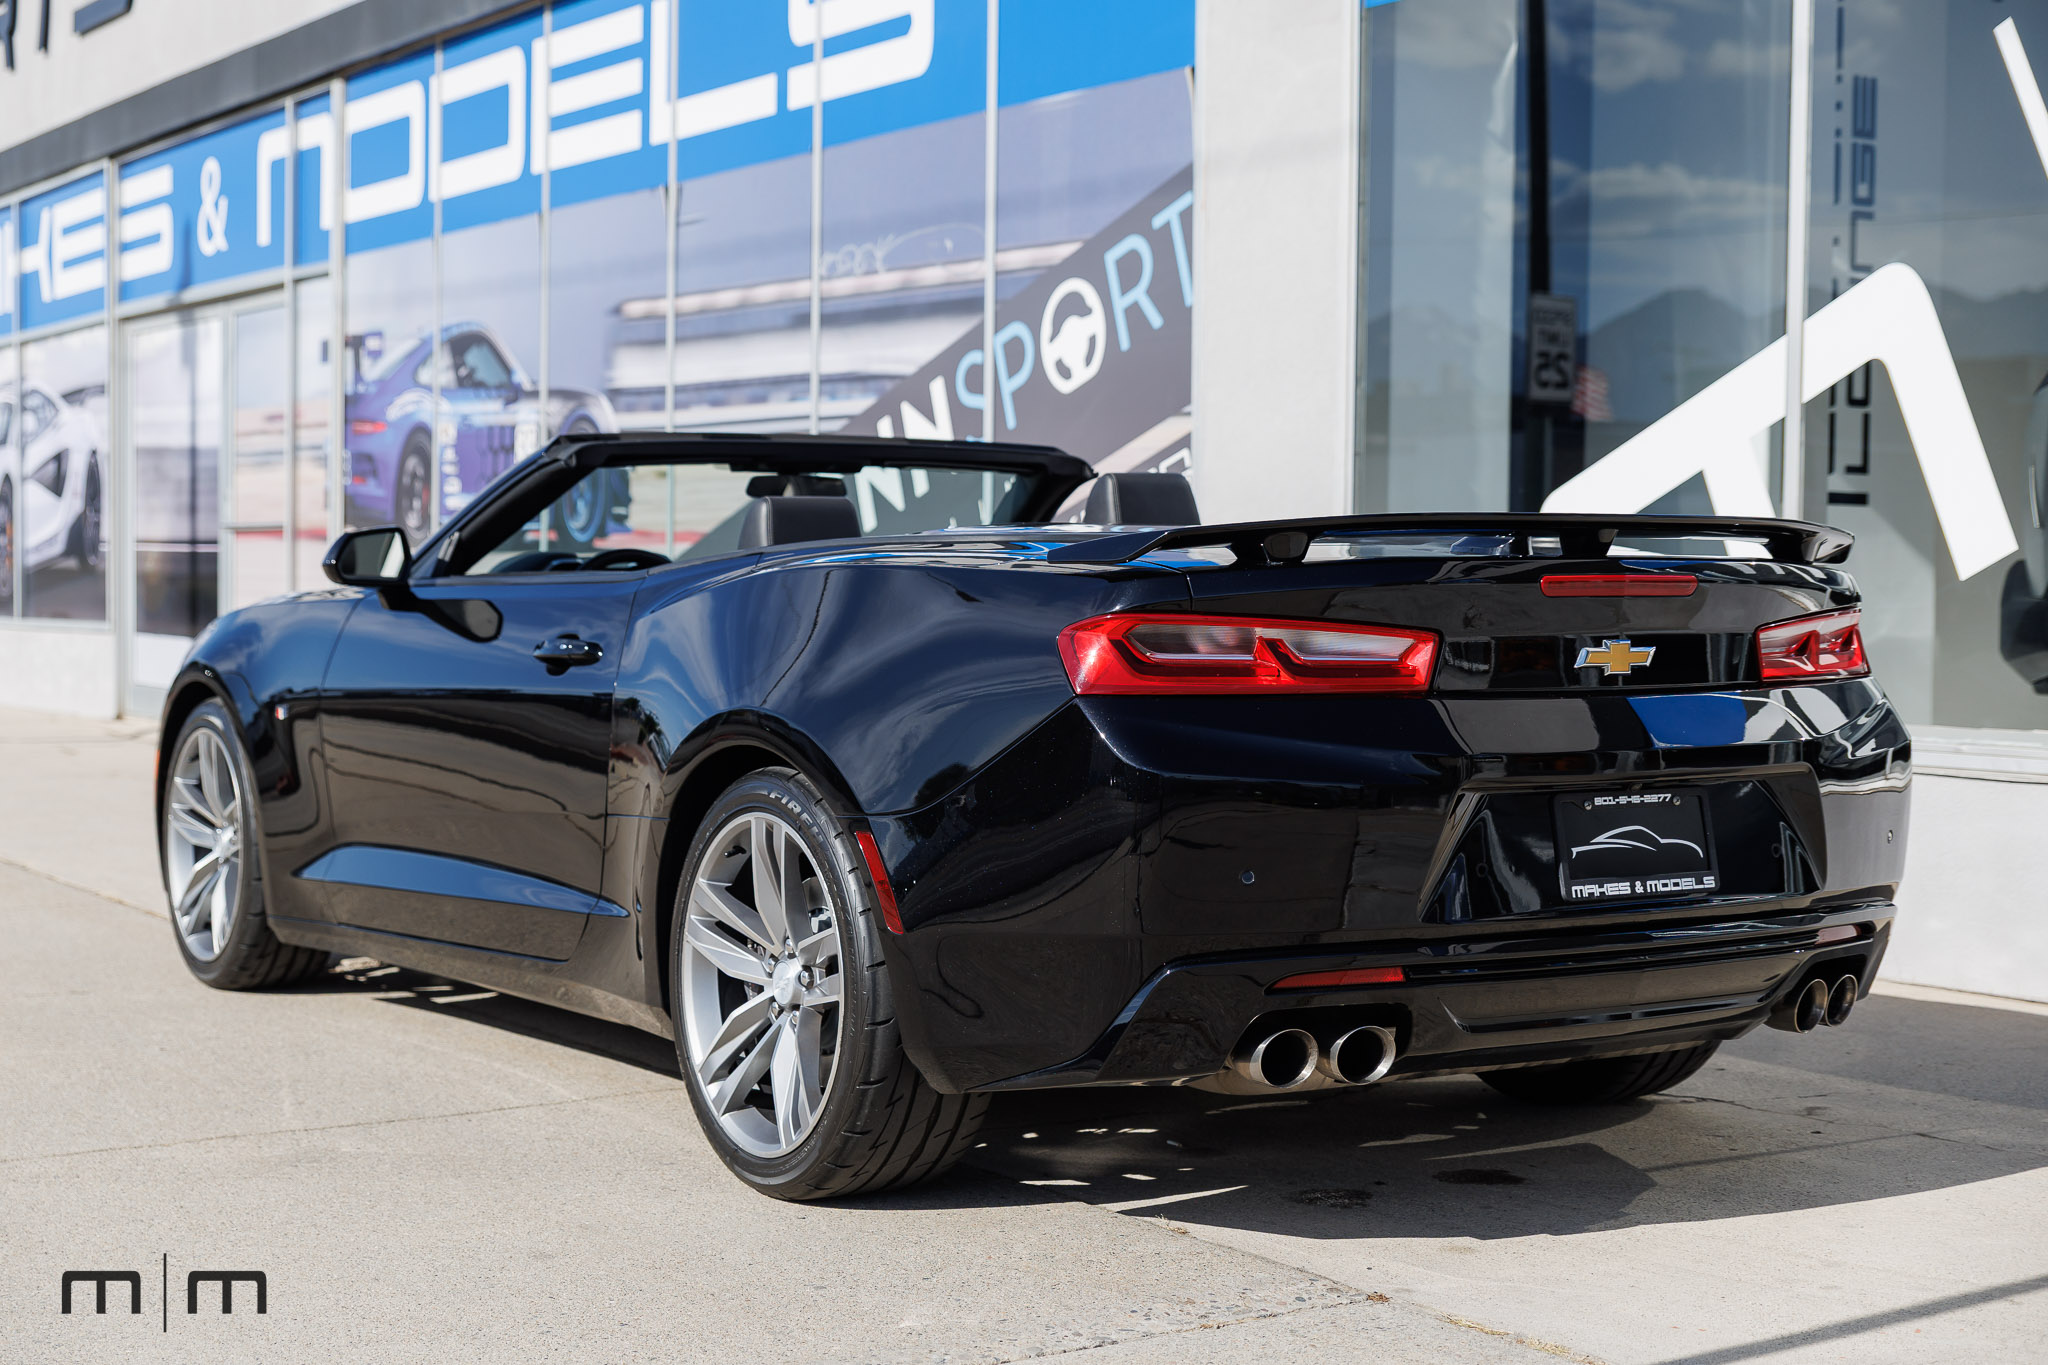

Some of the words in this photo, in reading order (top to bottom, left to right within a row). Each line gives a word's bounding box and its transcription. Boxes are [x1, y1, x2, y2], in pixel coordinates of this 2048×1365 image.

[0, 163, 174, 312] KES
[197, 156, 228, 256] &
[1571, 881, 1631, 899] MAKES
[1635, 881, 1644, 894] &
[1646, 876, 1716, 893] MODELS
